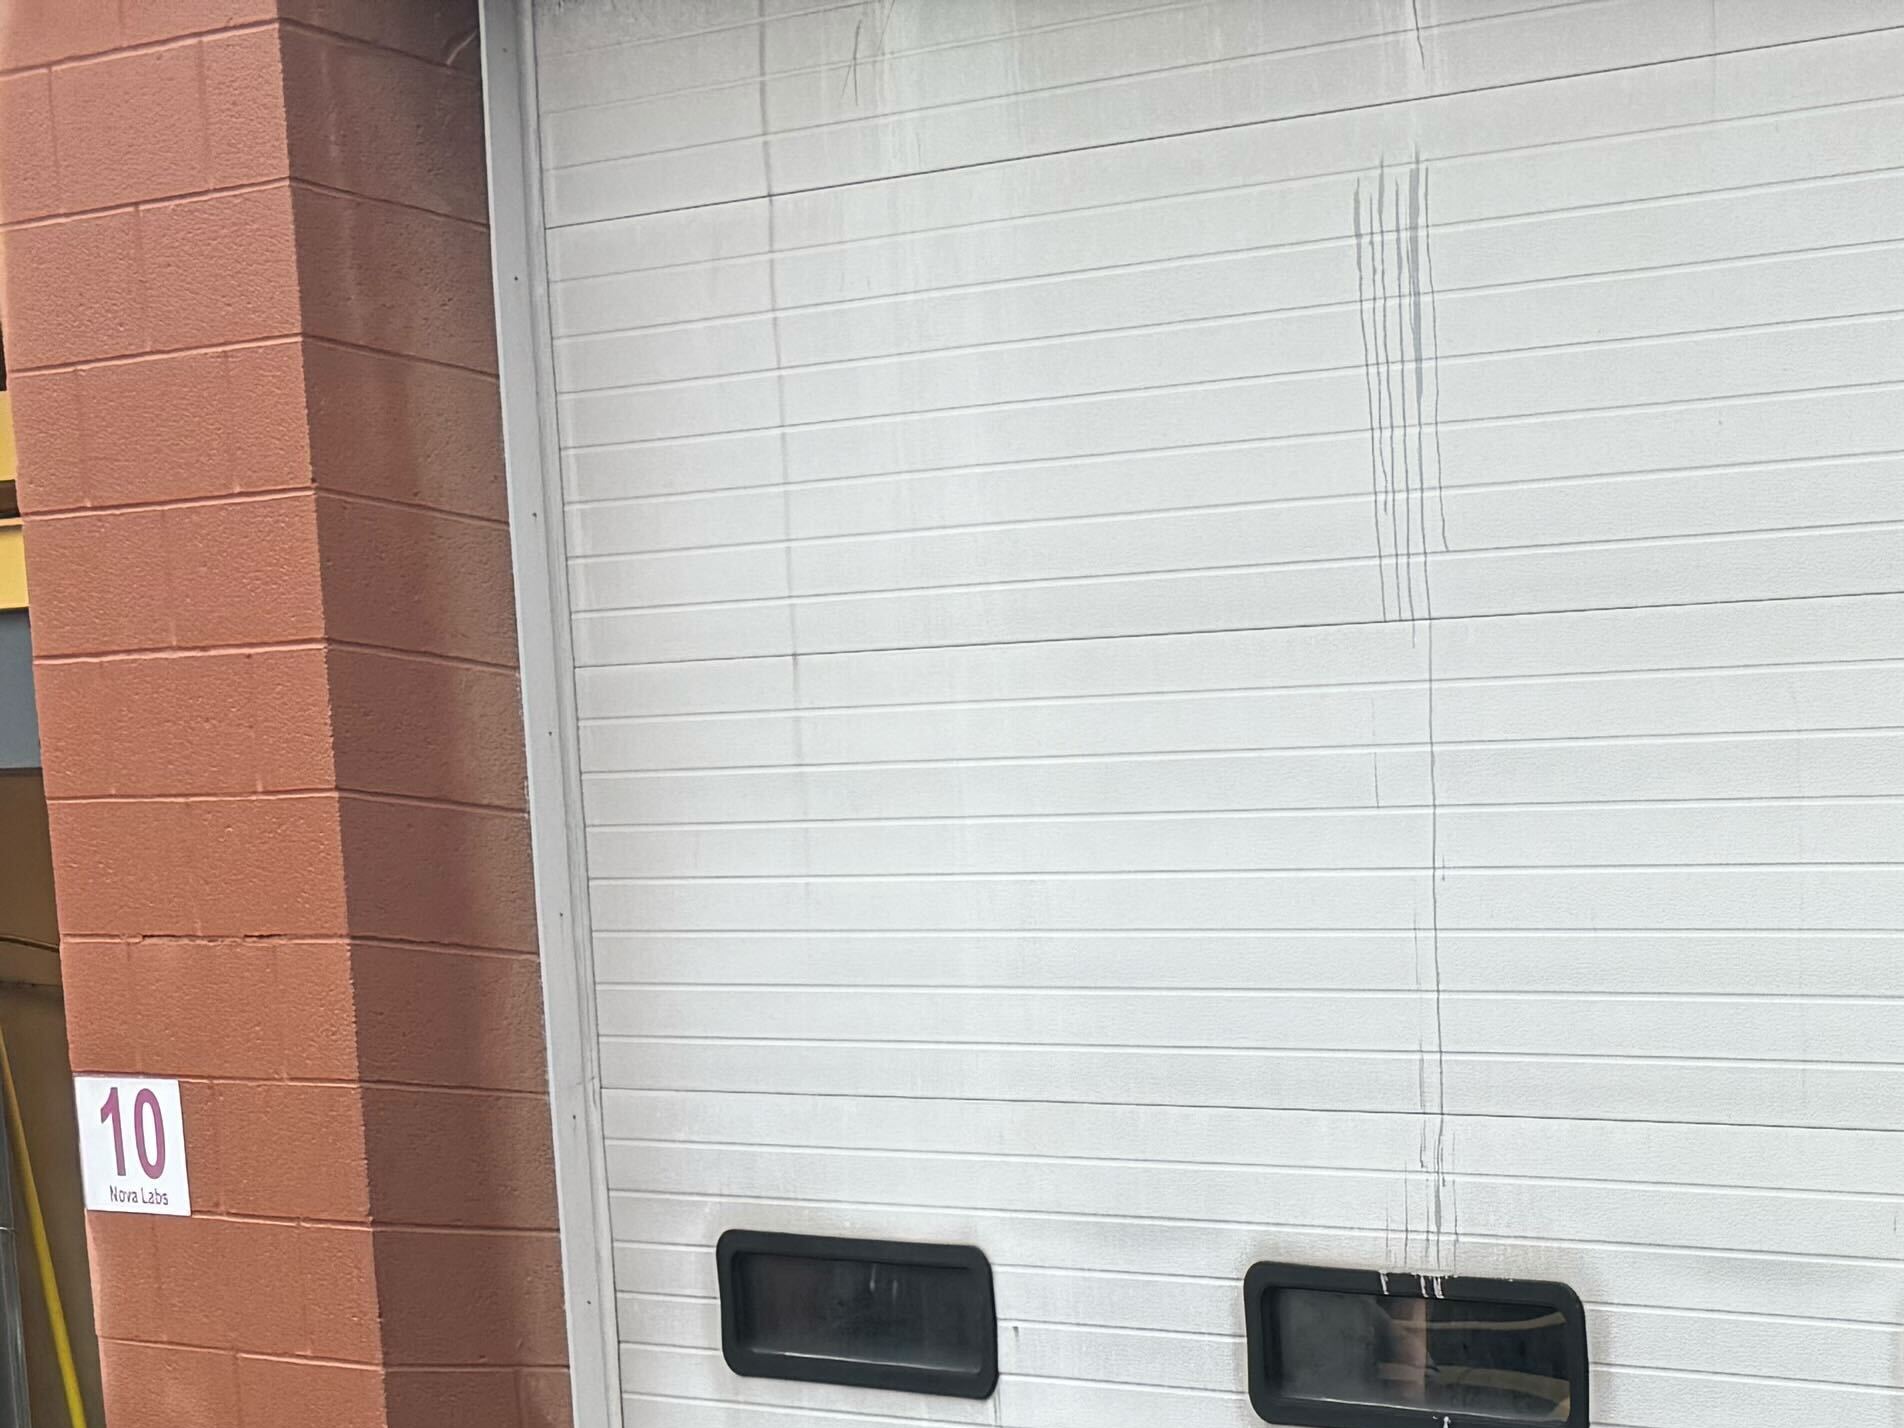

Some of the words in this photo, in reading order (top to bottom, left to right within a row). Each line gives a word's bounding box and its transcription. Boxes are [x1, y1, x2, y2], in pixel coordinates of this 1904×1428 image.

[100, 1086, 166, 1180] 10
[109, 1184, 138, 1205] Nova
[141, 1186, 169, 1206] Labs
